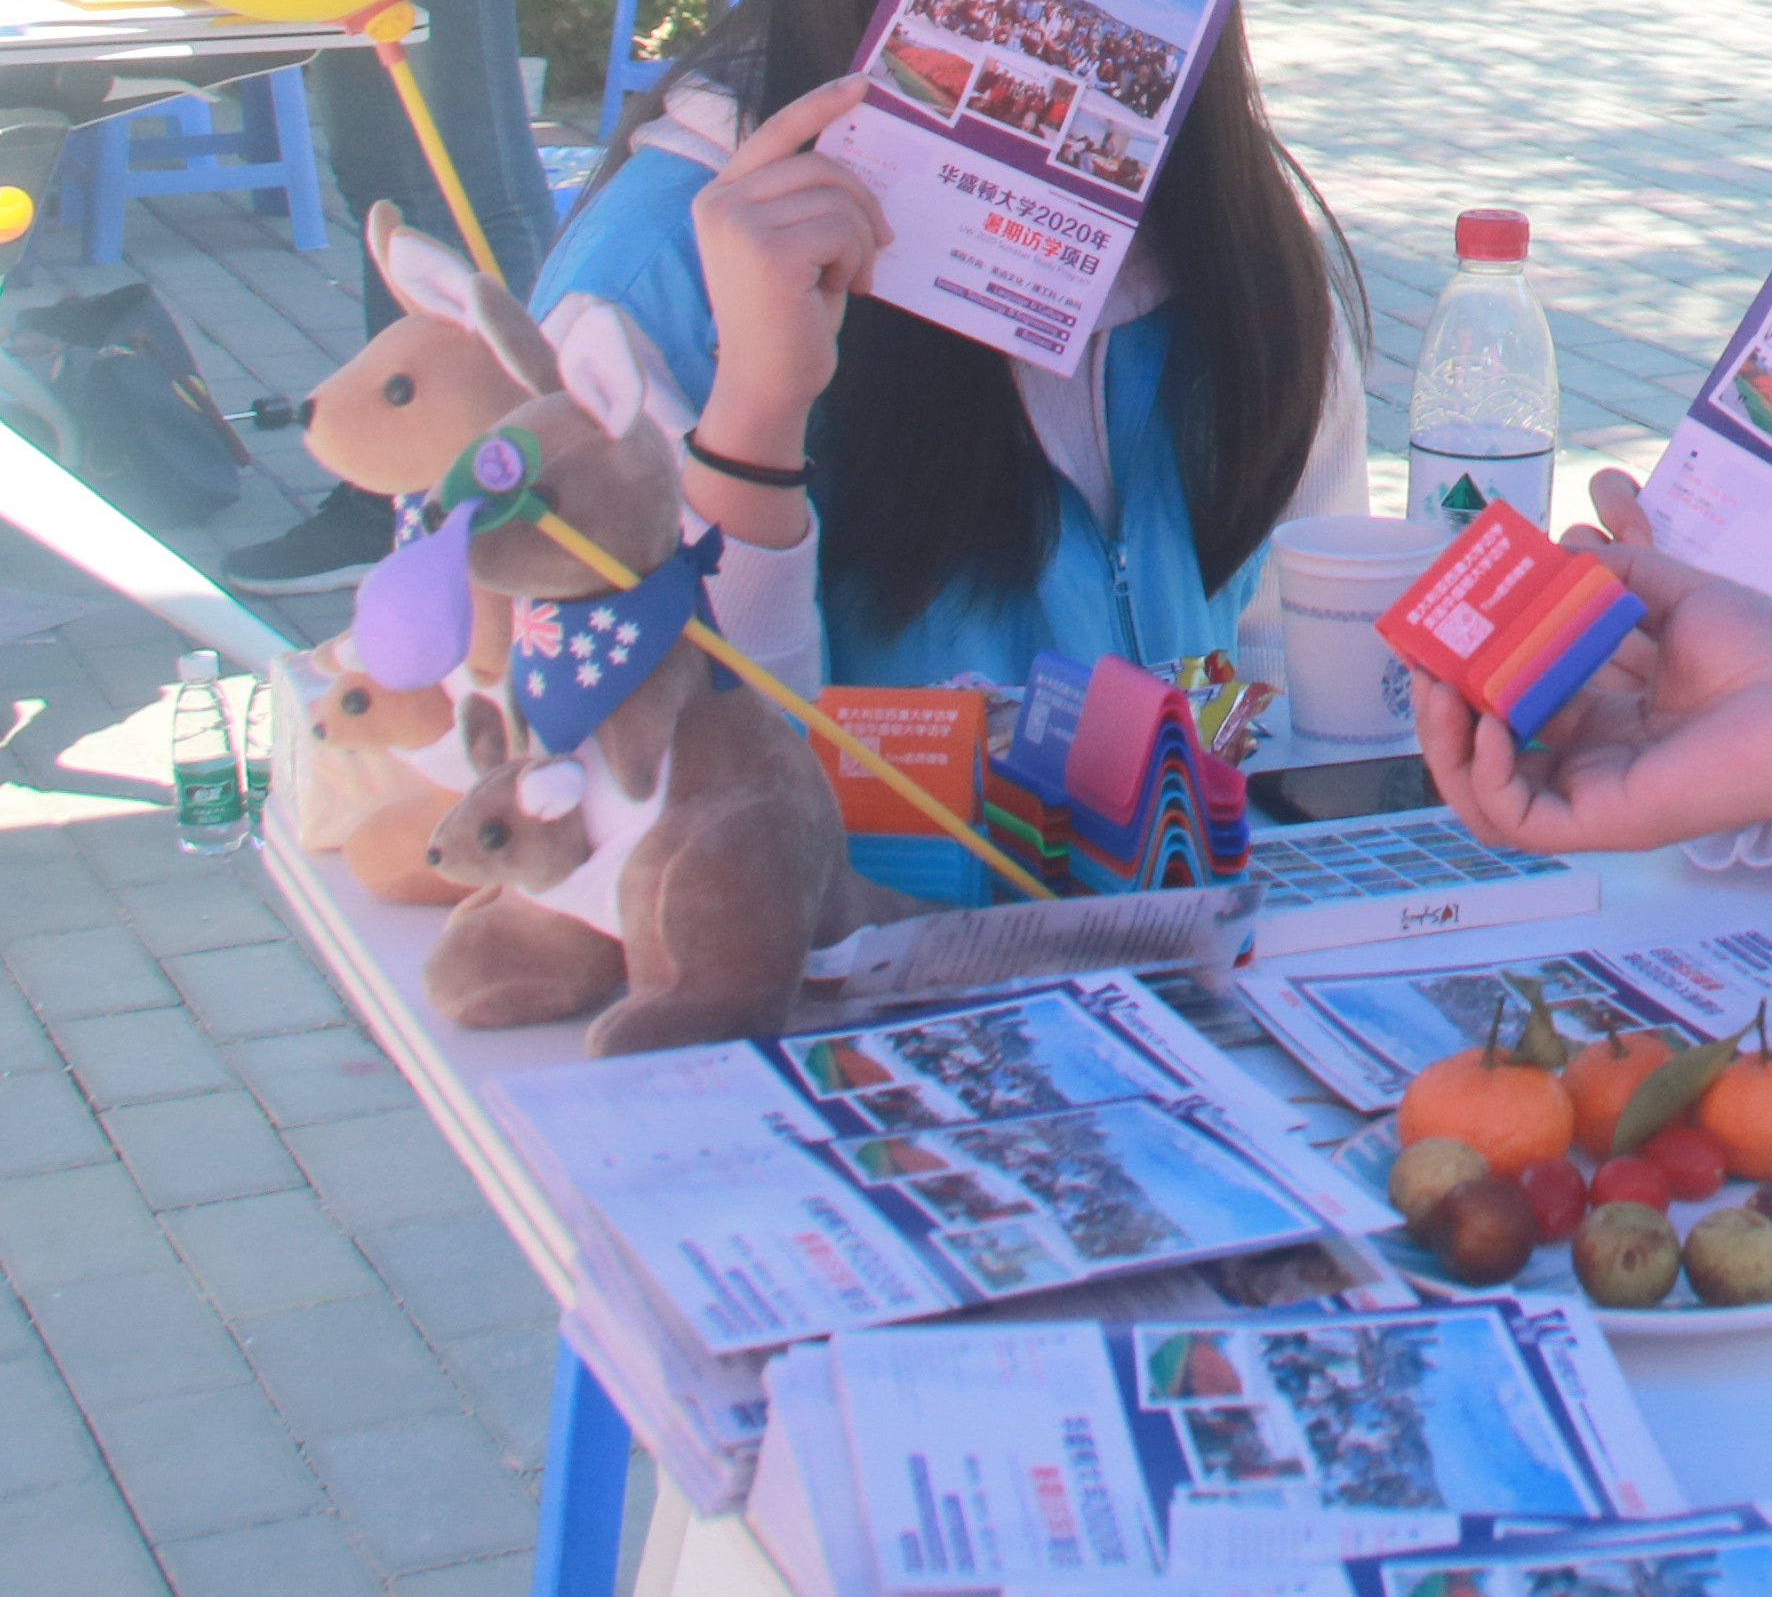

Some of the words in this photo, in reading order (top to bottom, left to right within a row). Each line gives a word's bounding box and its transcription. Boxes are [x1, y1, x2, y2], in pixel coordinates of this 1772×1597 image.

[937, 161, 1113, 253] 华盛顿大学2020年
[981, 210, 1101, 276] 暑期访学项目
